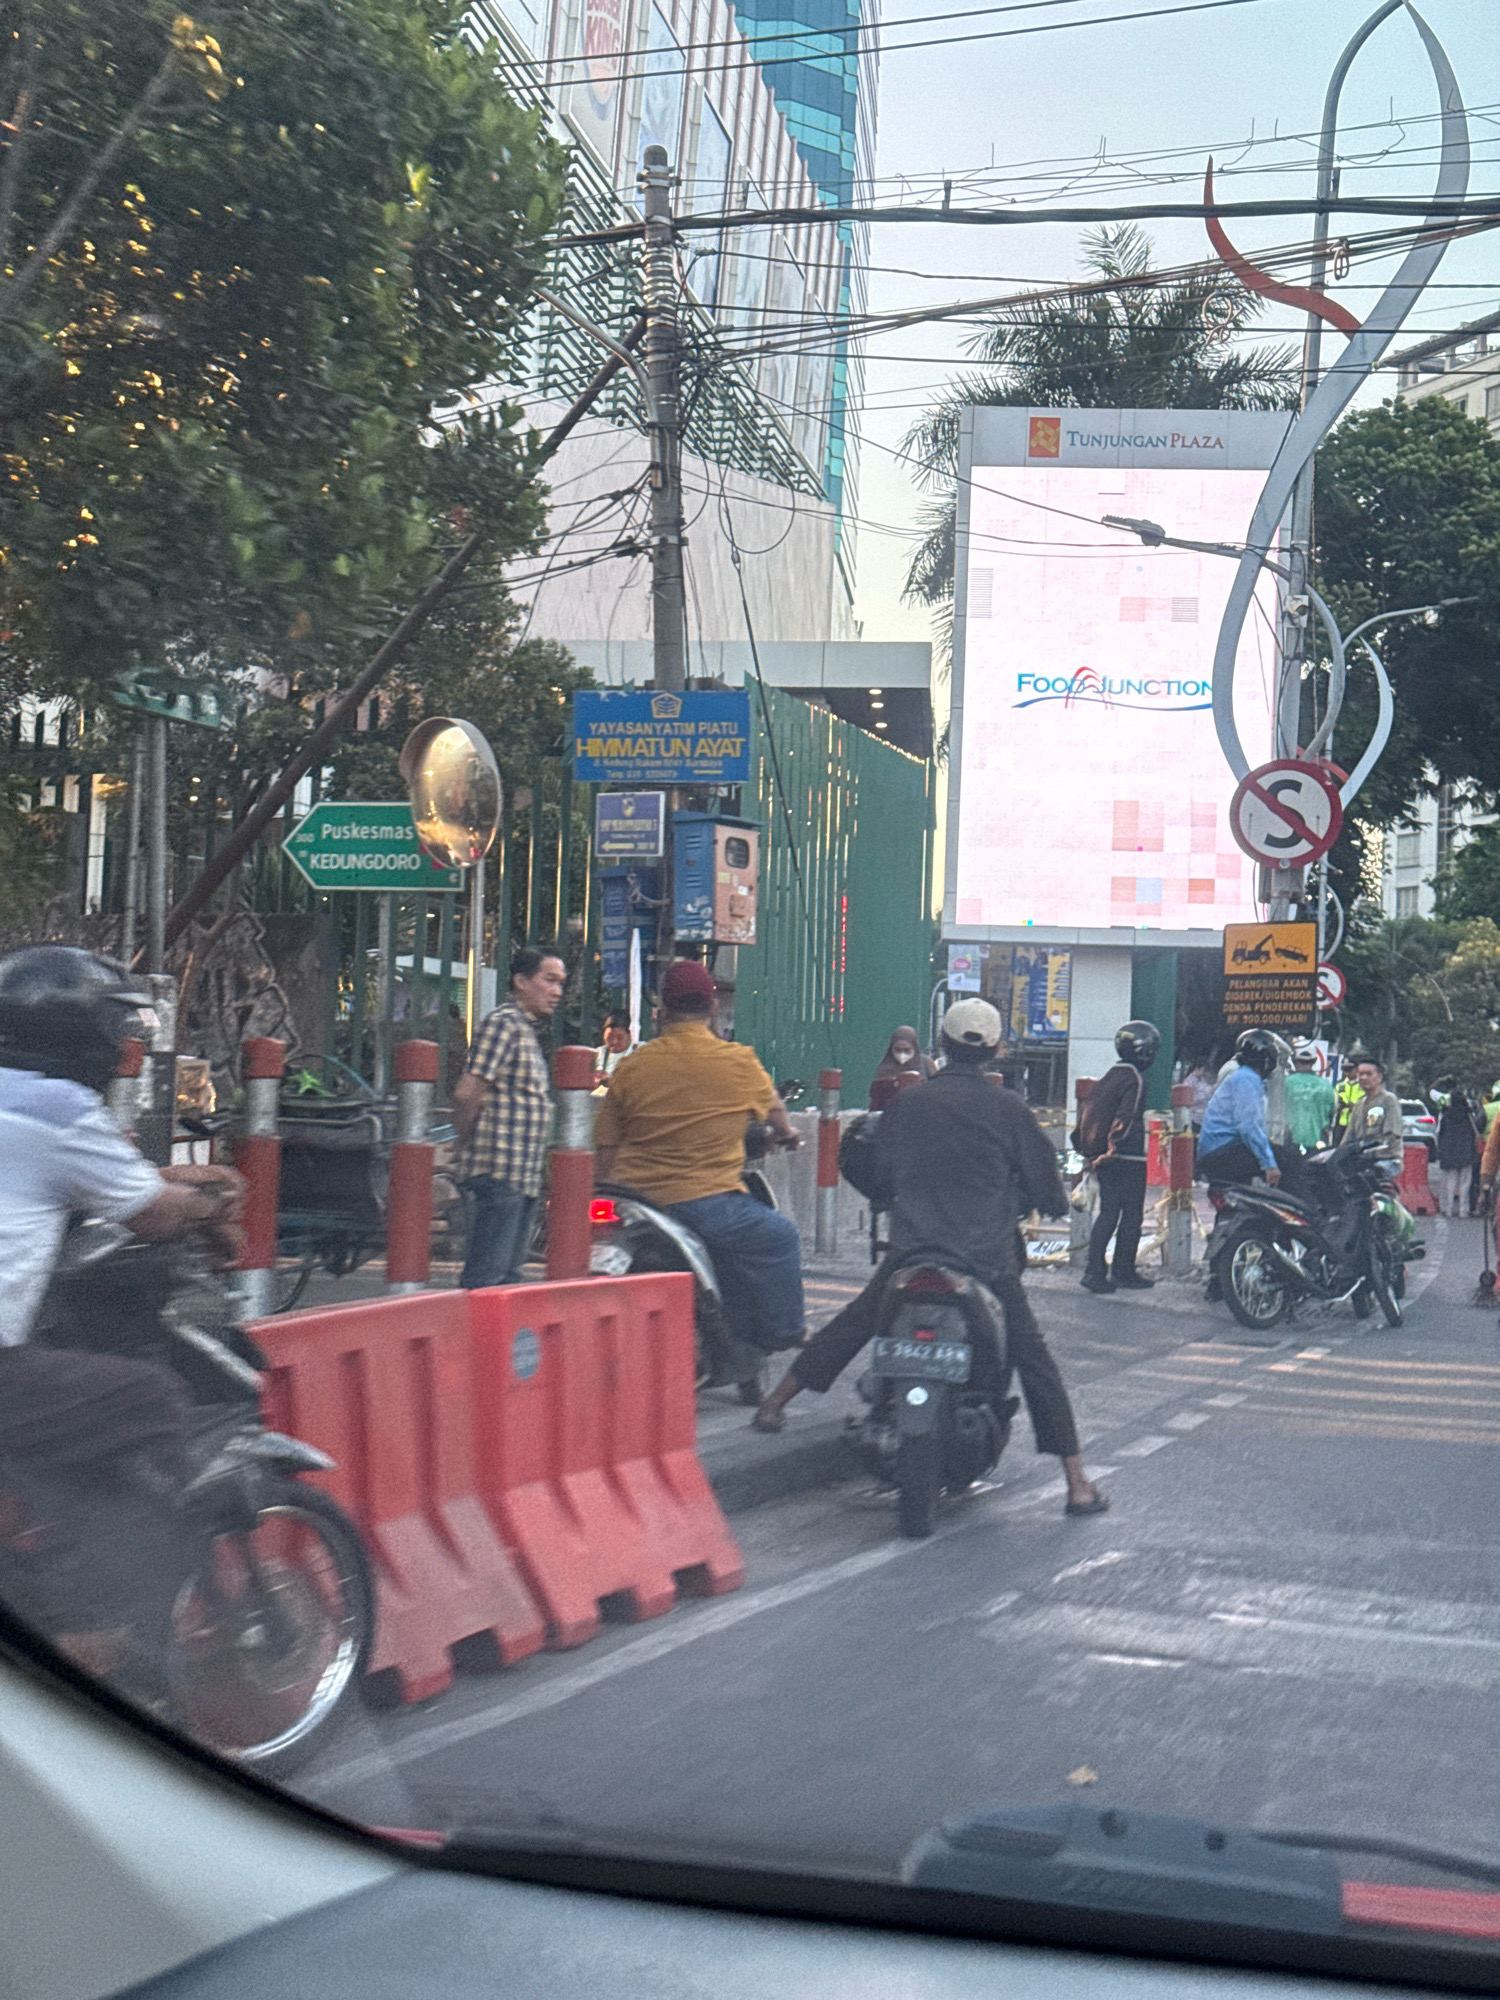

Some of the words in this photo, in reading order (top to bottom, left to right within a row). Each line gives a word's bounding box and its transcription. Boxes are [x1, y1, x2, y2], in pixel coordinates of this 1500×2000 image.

[589, 722, 651, 735] YAYASAN
[653, 722, 695, 735] YATIM
[698, 722, 738, 735] PIATU
[576, 738, 691, 758] HIMMATUN
[694, 738, 746, 758] AYAT
[1264, 779, 1306, 849] S
[321, 822, 414, 840] Puskesmas
[309, 853, 421, 870] KEDUNGDORO
[1282, 978, 1308, 989] AKAN
[1223, 1003, 1252, 1013] DENDA
[1254, 1002, 1313, 1013] PENDEREKAN
